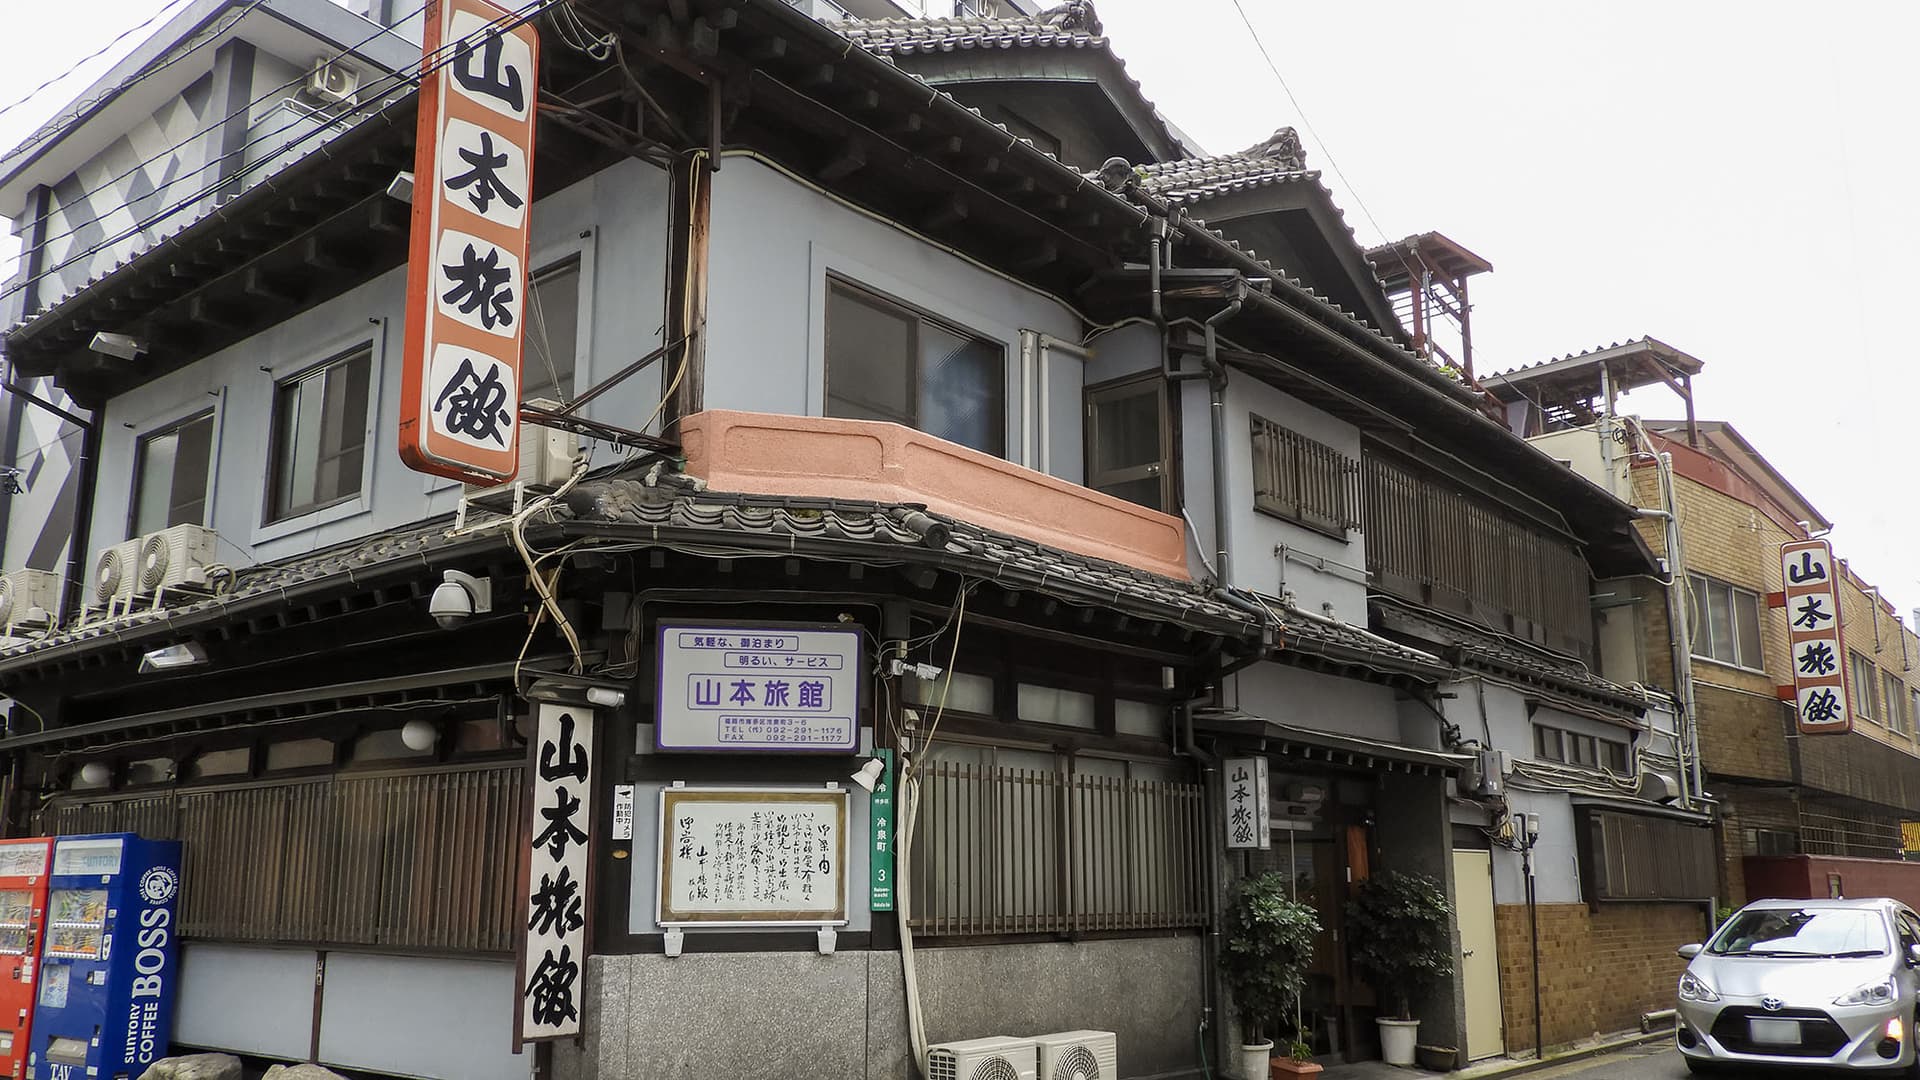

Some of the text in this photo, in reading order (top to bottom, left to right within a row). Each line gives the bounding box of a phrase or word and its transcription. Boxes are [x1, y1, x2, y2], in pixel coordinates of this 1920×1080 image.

[693, 636, 785, 649] 気軽な、御泊まり
[739, 655, 829, 668] 明るい、サービス
[696, 679, 825, 708] 山本旅館
[725, 726, 744, 734] TEL
[876, 817, 887, 852] 冷泉町
[878, 869, 886, 881] 3
[131, 907, 170, 999] BOSS
[124, 1003, 141, 1064] SUNTORY
[138, 1002, 158, 1064] COFFEE
